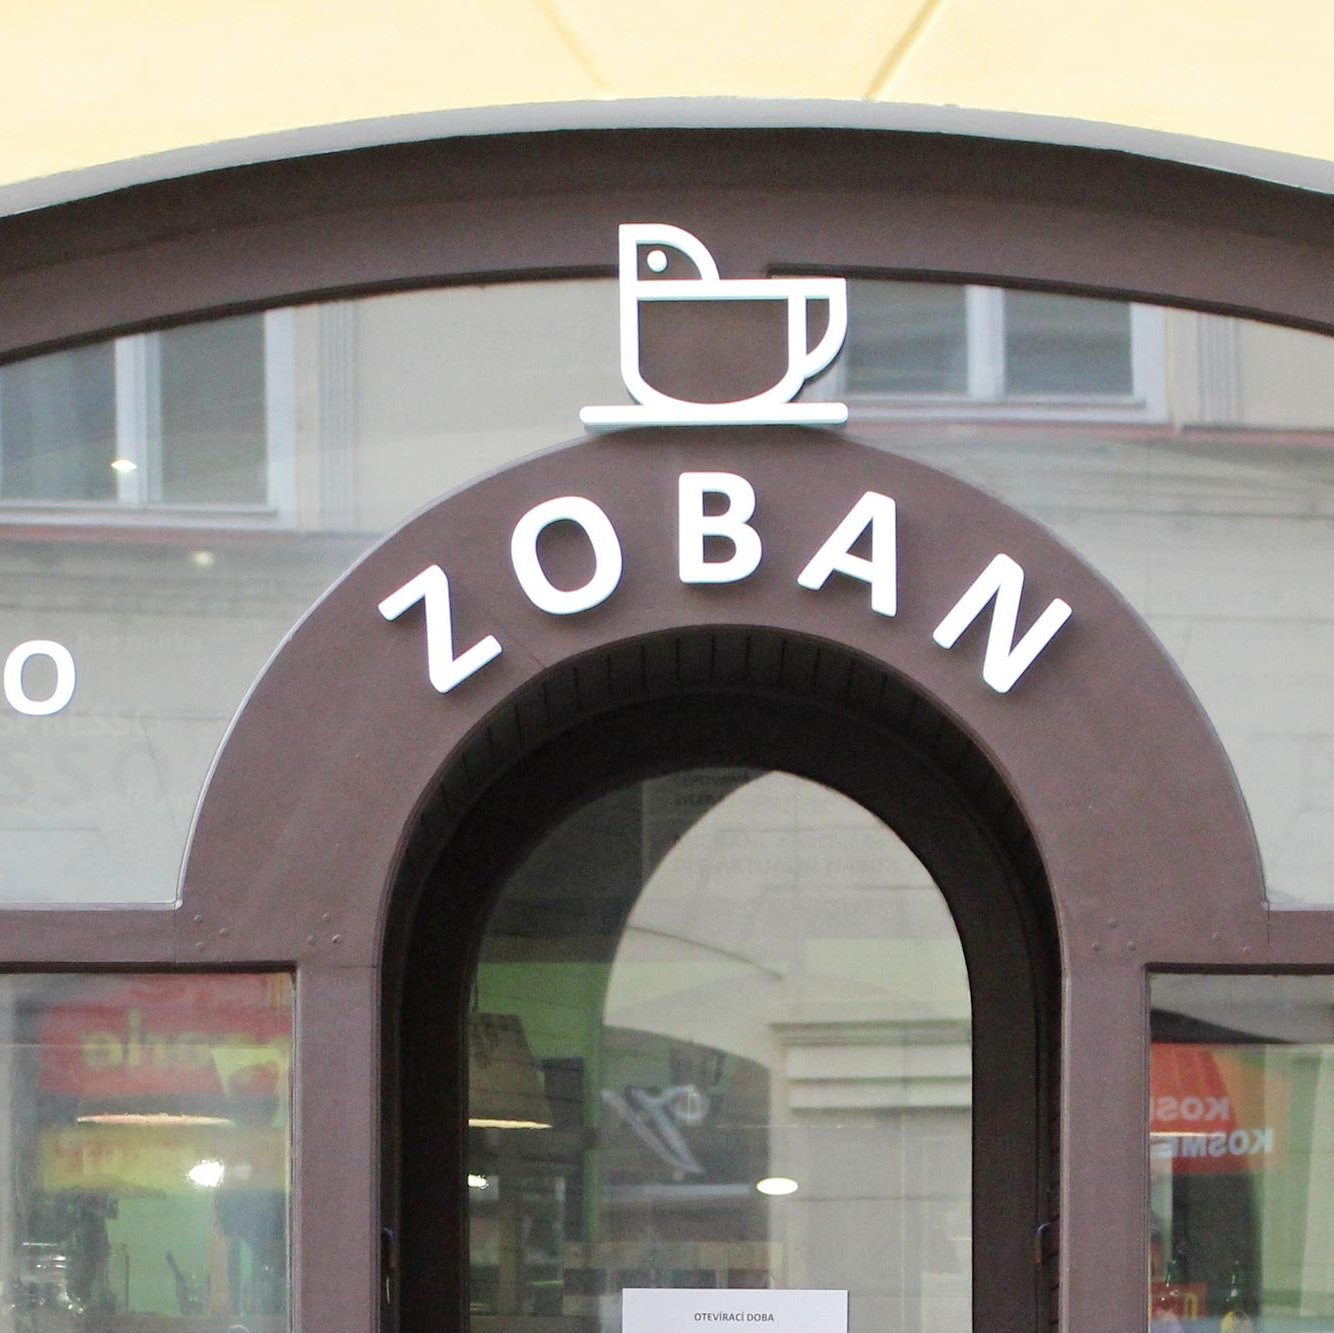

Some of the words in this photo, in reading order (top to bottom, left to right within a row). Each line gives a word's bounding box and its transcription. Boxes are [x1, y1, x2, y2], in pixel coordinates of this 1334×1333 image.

[378, 472, 1072, 694] ZOBAN
[693, 1311, 745, 1322] OTEVÍRACÍ
[746, 1313, 775, 1322] DOBA
